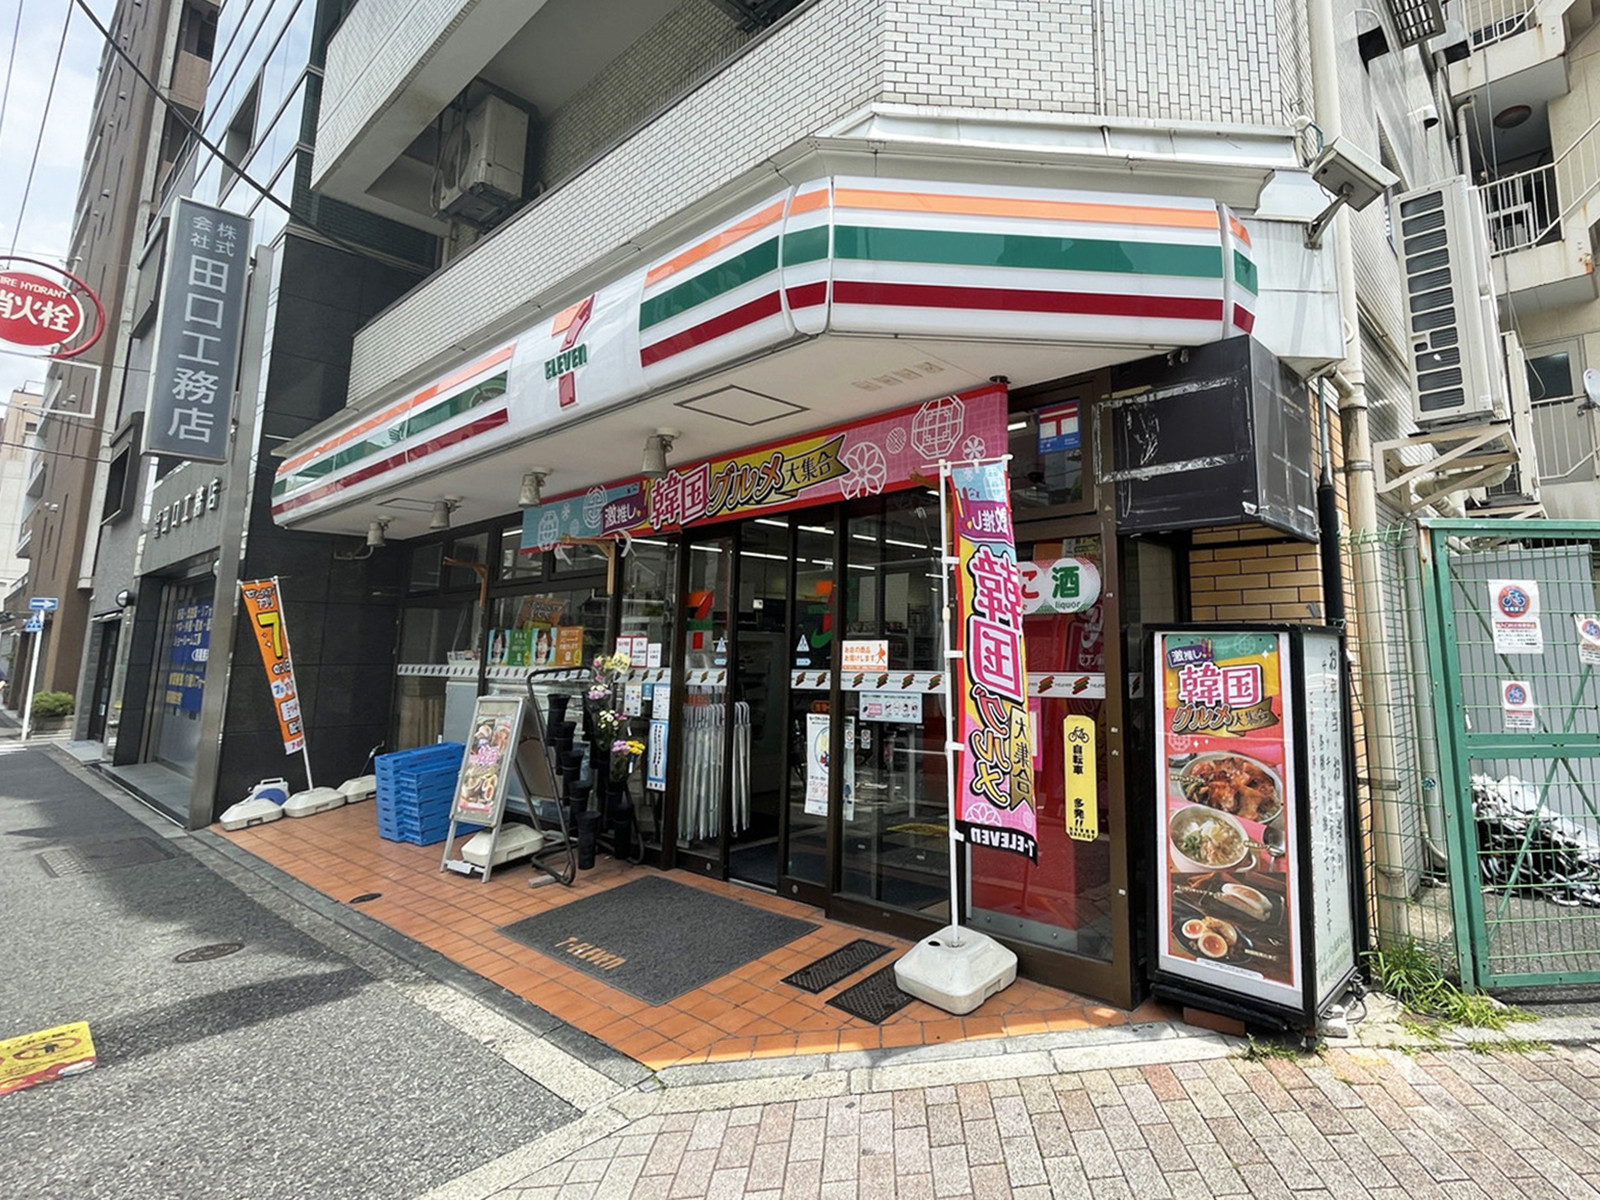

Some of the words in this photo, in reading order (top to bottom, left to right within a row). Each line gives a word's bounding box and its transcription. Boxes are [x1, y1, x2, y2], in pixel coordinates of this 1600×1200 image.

[0, 276, 18, 287] IRE
[20, 281, 67, 299] HYDRANT
[168, 254, 229, 444] 田口工務店
[551, 293, 596, 408] 7
[785, 451, 834, 486] 大集合
[1052, 566, 1080, 599] 酒
[1055, 601, 1081, 610] liquor
[257, 612, 283, 659] 7
[1233, 707, 1270, 727] 大集合
[1072, 744, 1084, 775] 自転車
